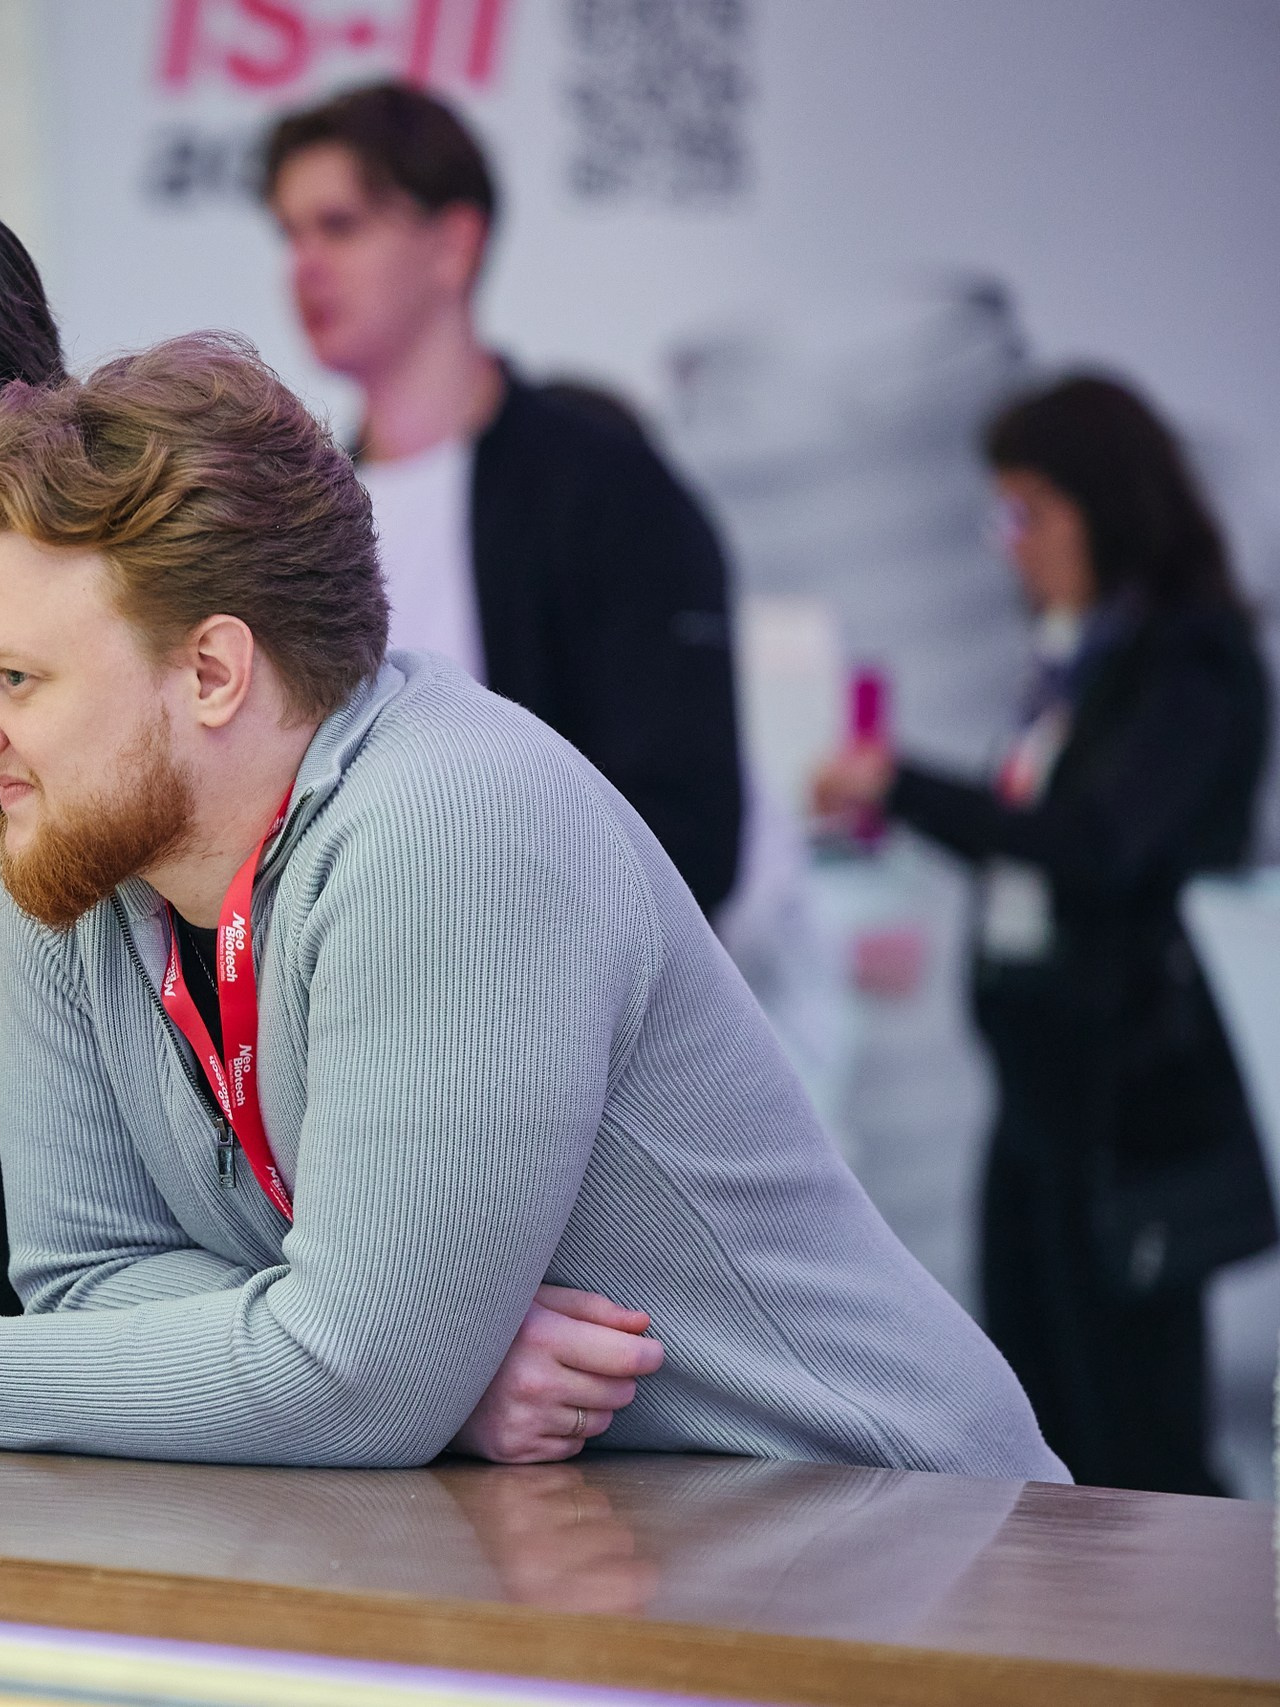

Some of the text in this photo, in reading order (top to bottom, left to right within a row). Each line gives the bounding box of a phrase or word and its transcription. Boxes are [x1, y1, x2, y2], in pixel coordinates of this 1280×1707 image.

[232, 910, 248, 950] Neo
[225, 925, 239, 983] Biotech
[239, 1043, 254, 1073] Neo
[233, 1057, 246, 1107] Biotech
